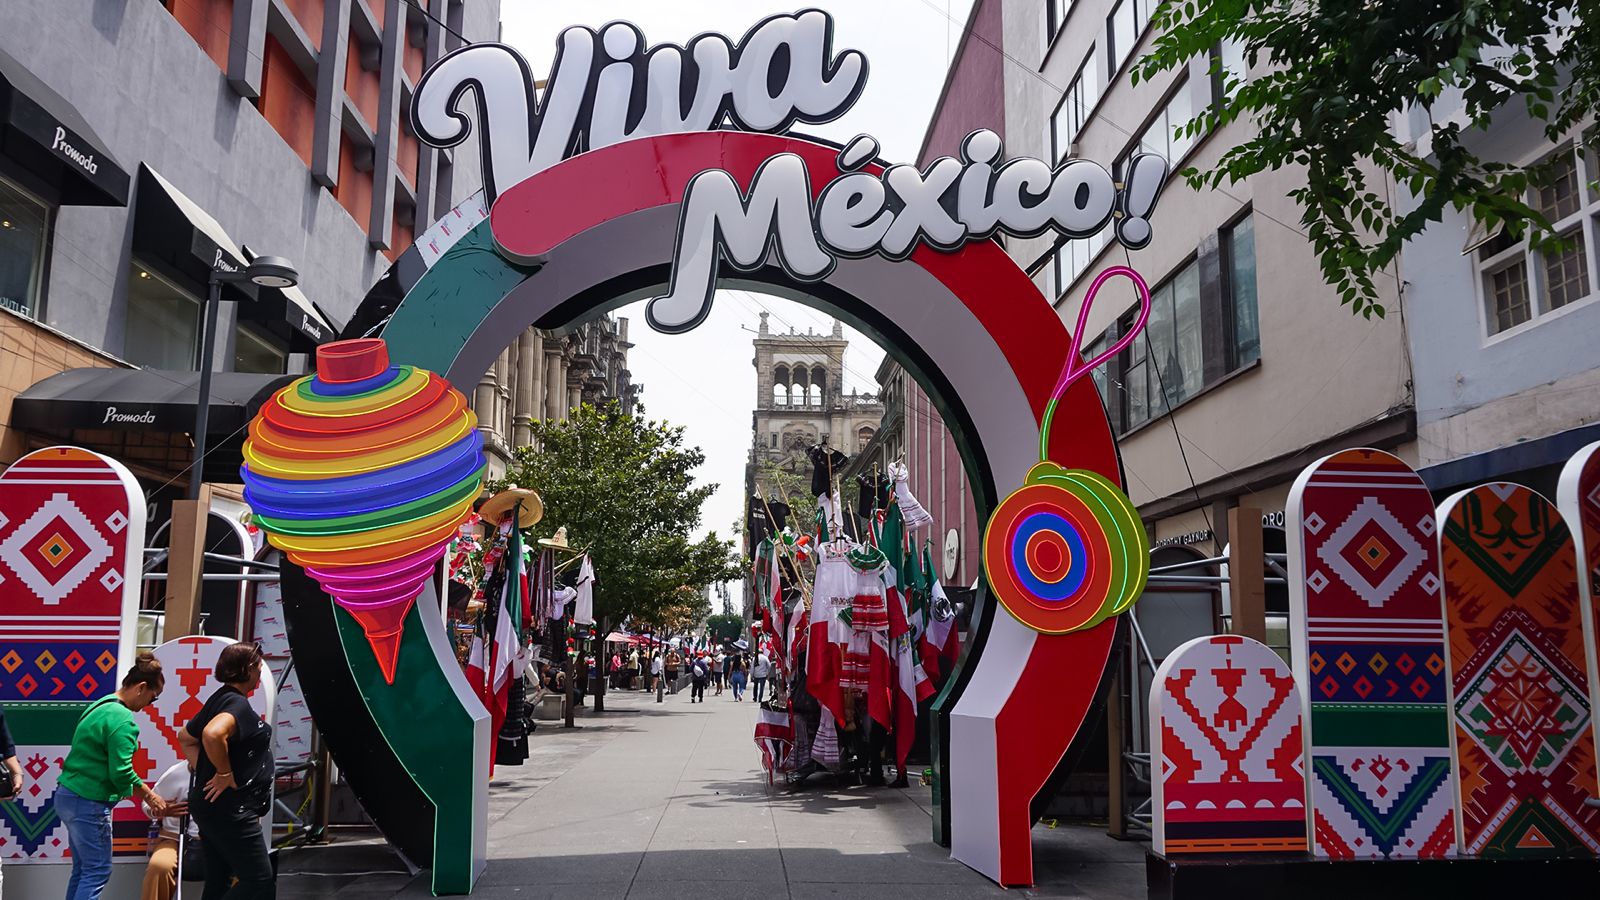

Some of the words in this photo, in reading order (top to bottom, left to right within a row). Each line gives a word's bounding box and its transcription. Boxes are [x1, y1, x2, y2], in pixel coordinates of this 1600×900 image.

[412, 9, 869, 210] Viva
[52, 126, 98, 175] Promoda
[646, 131, 1168, 334] México!
[0, 296, 31, 317] OUTLET
[102, 406, 156, 424] Promoda
[1183, 529, 1208, 545] GAYNOR
